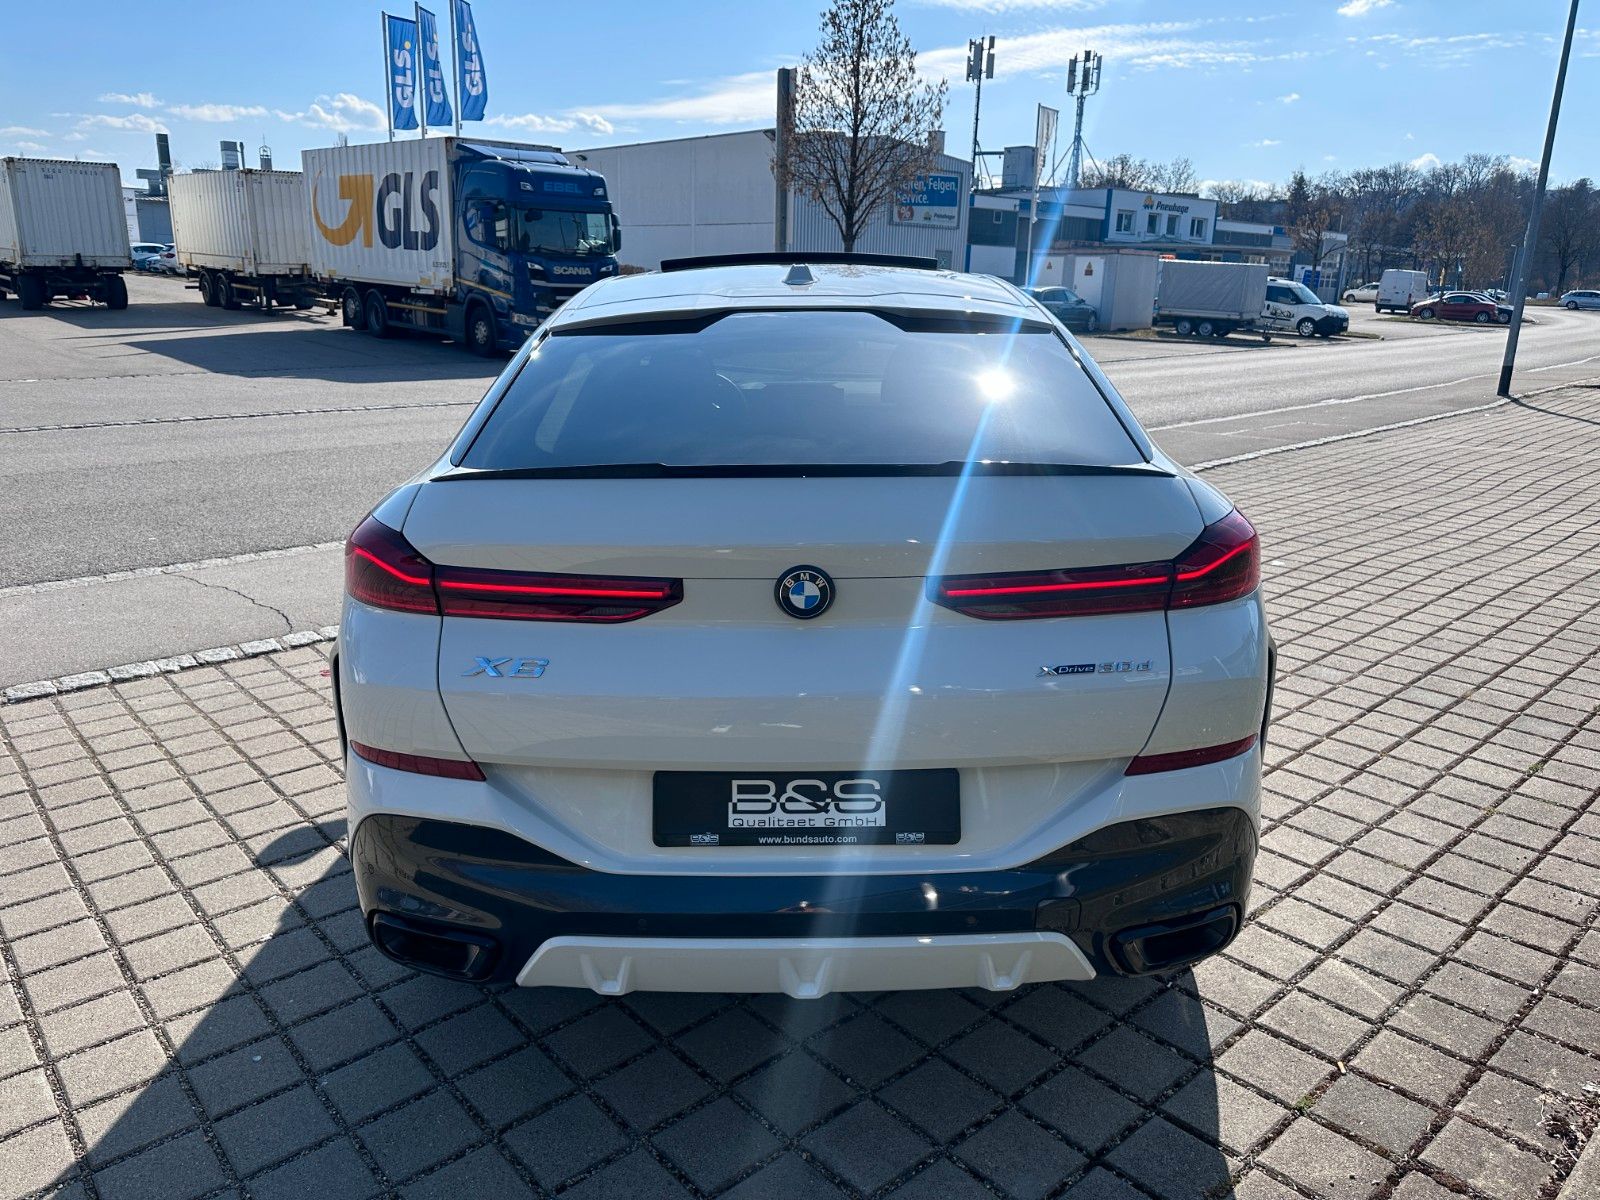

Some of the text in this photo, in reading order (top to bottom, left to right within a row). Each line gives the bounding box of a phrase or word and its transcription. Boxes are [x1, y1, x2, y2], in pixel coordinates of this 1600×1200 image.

[461, 31, 483, 96] GLS
[393, 48, 413, 108] GLS
[543, 181, 583, 193] EBEL
[928, 177, 957, 194] Felgen,
[377, 170, 440, 251] GLS
[553, 265, 592, 275] SCANIA
[785, 572, 826, 588] BMW
[460, 657, 550, 679] X6
[731, 779, 881, 815] B&S
[733, 816, 816, 827] Qualitaet
[758, 835, 857, 844] www.bundsauto.com
